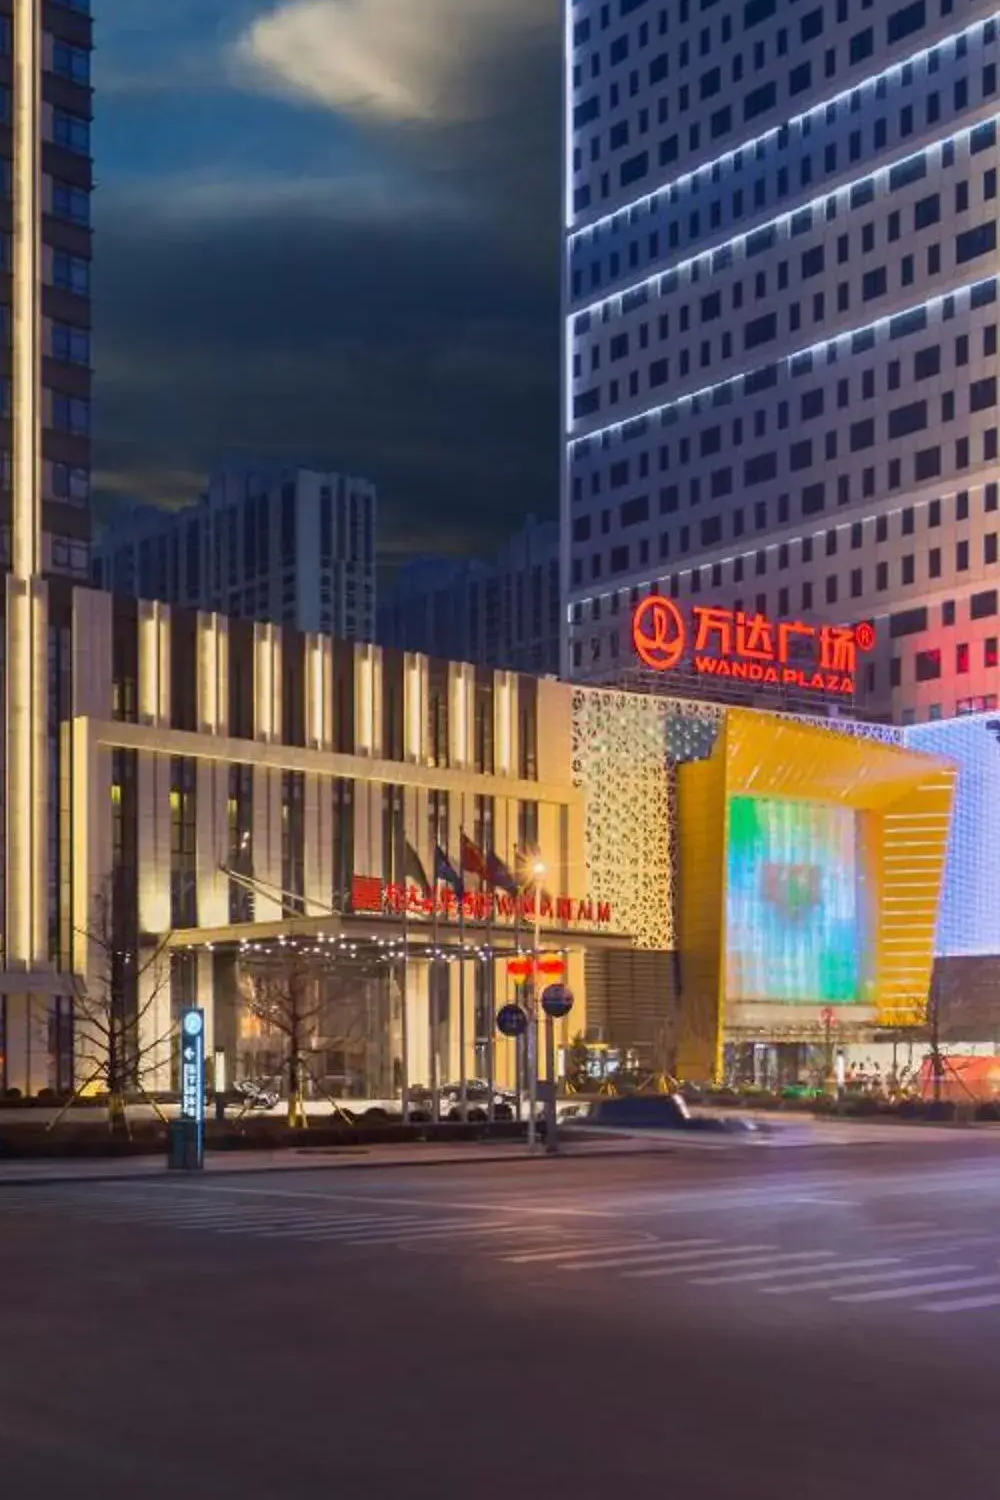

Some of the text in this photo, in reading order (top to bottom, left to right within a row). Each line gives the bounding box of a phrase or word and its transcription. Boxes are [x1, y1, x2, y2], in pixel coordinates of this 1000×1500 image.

[694, 606, 857, 672] 万达广场
[695, 656, 854, 693] WANDA PLAZA
